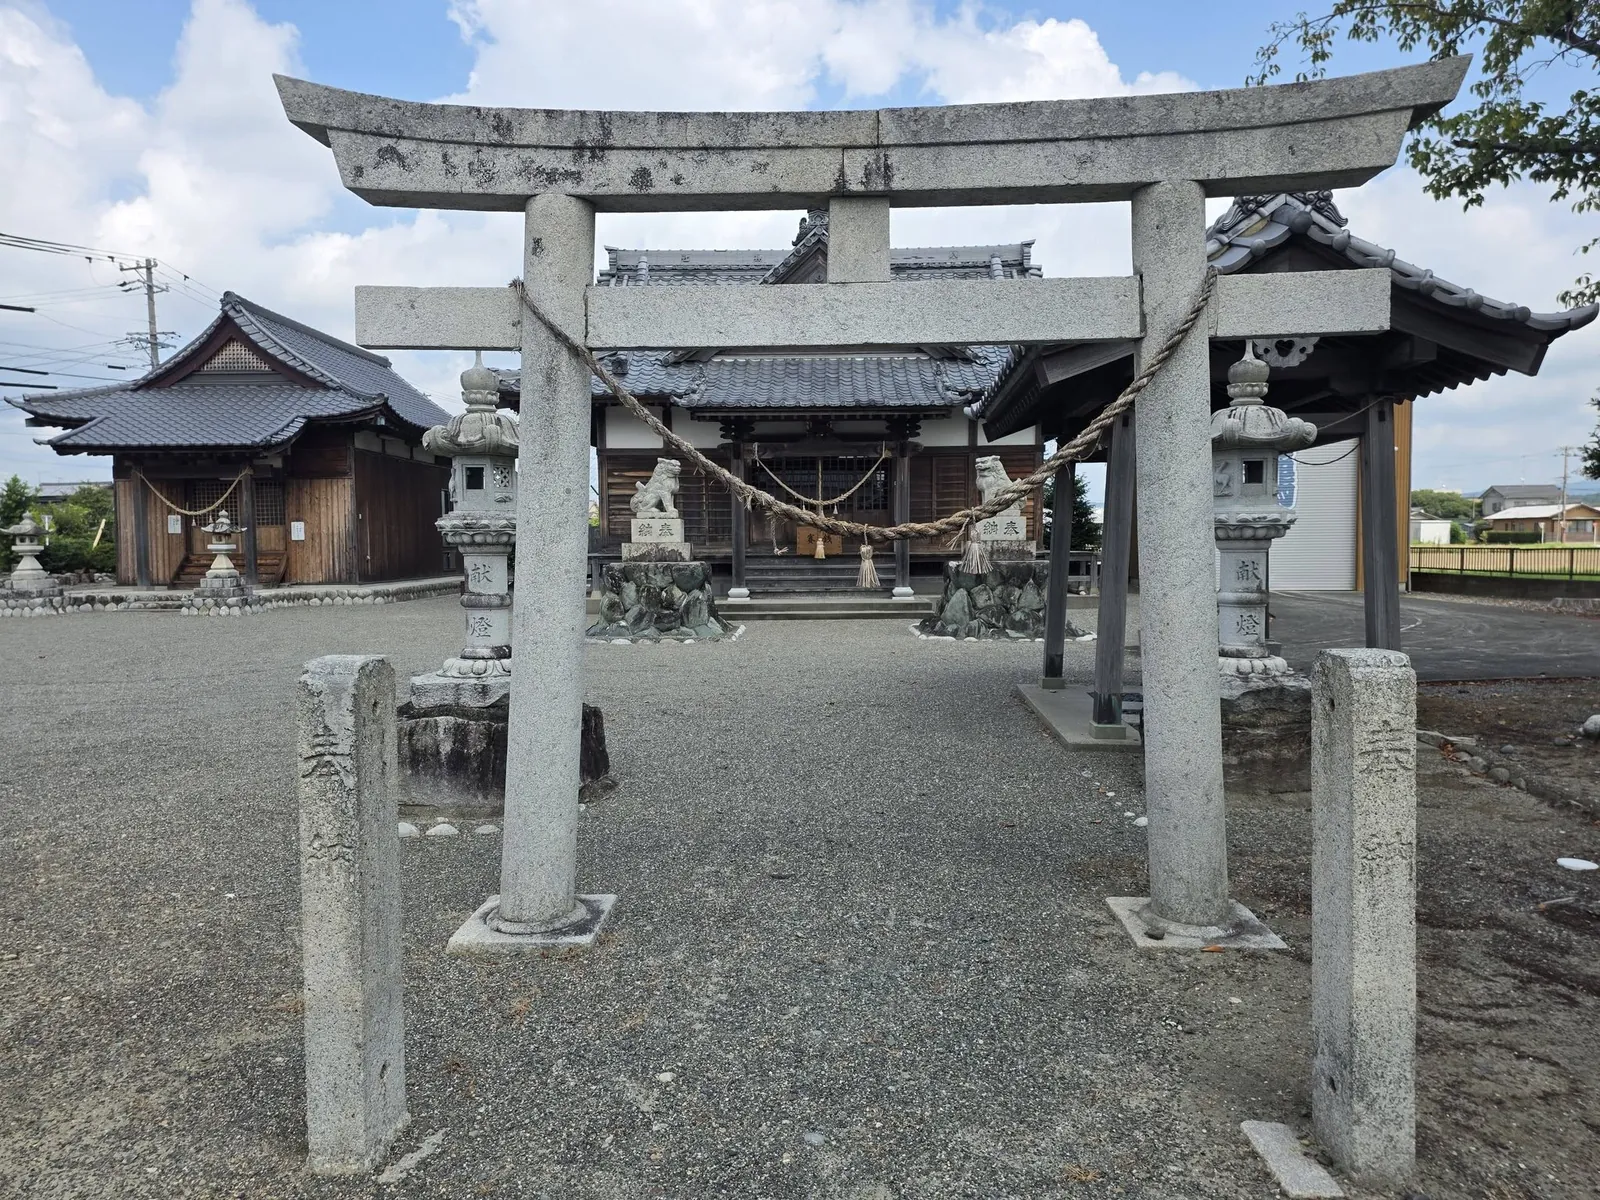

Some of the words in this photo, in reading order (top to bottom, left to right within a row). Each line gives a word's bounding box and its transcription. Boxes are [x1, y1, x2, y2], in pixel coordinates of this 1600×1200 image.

[638, 522, 674, 538] 奉納
[983, 520, 1020, 537] 奉納
[470, 563, 493, 638] 献燈
[1236, 560, 1261, 636] 献燈
